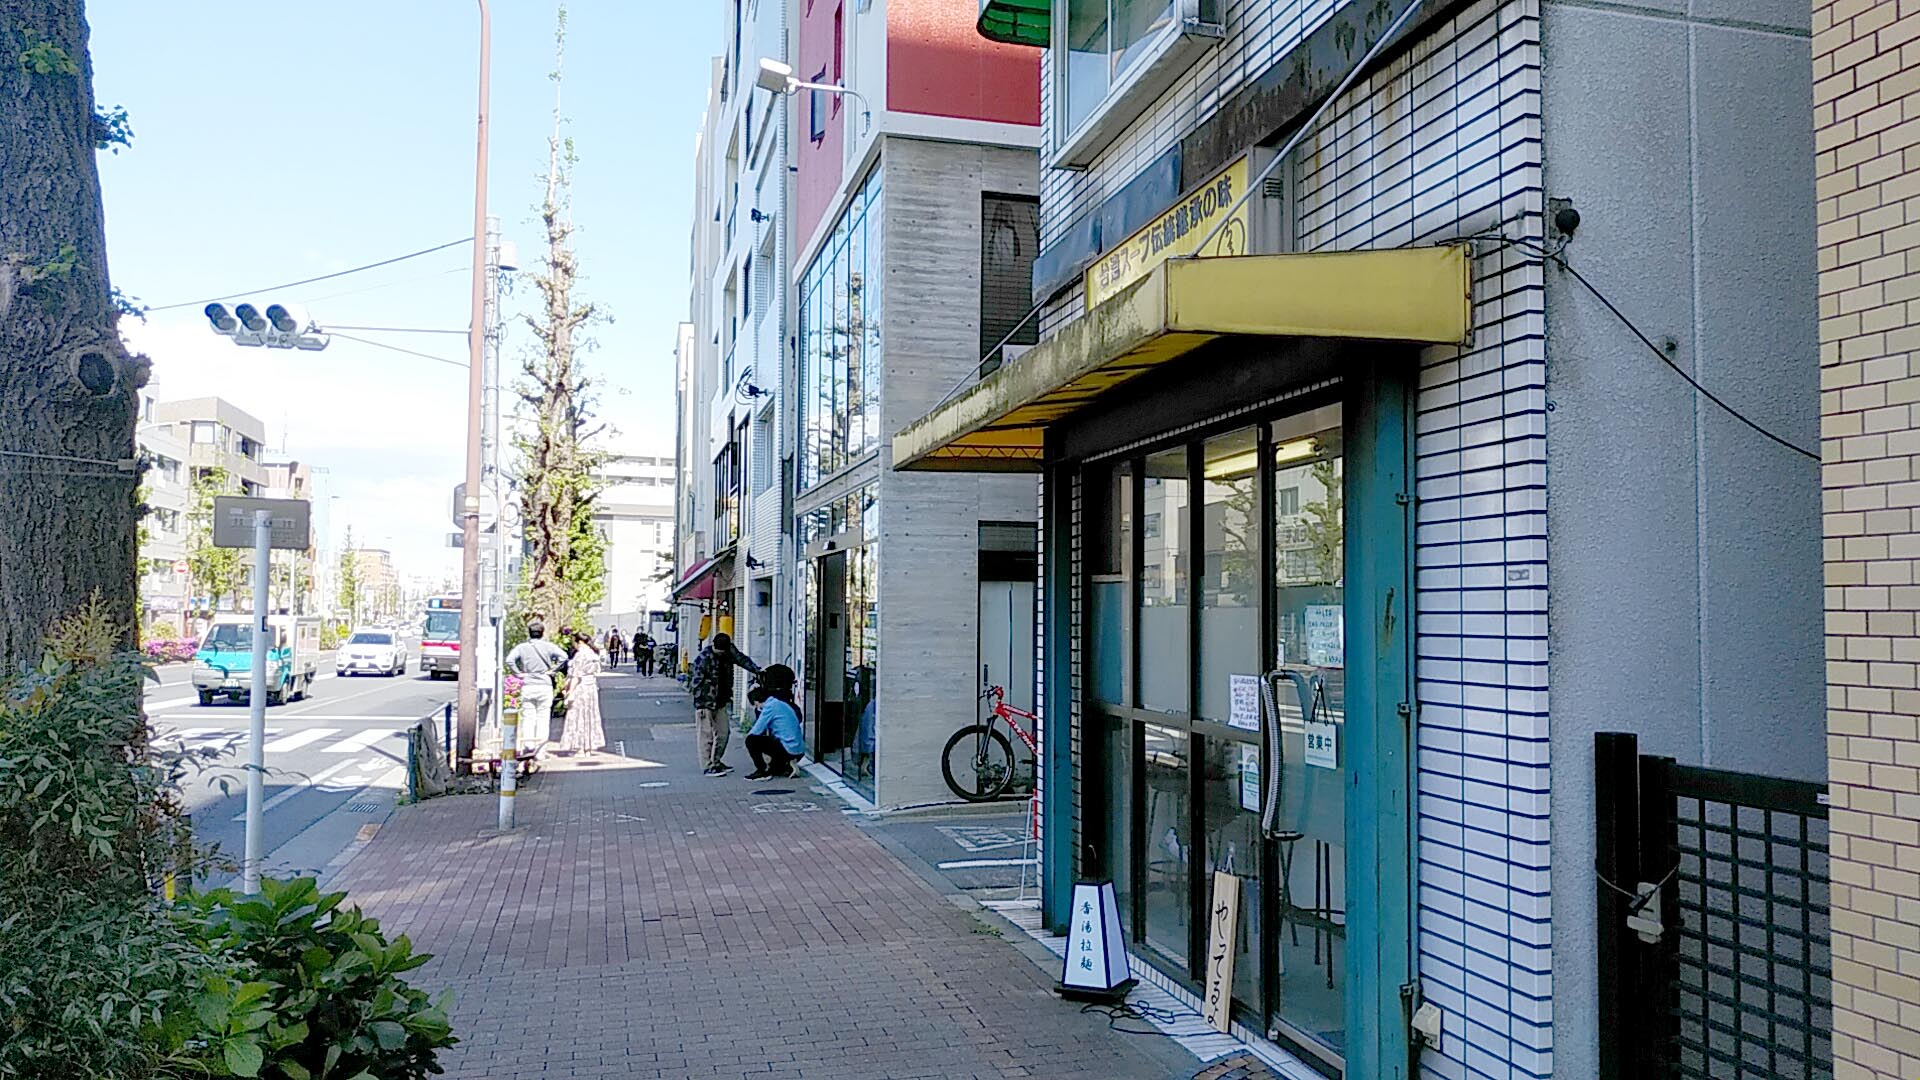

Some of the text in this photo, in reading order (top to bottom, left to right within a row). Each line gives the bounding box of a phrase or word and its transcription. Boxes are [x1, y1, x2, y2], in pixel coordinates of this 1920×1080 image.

[1308, 732, 1332, 752] 営業中
[1207, 899, 1229, 1027] やってるよ
